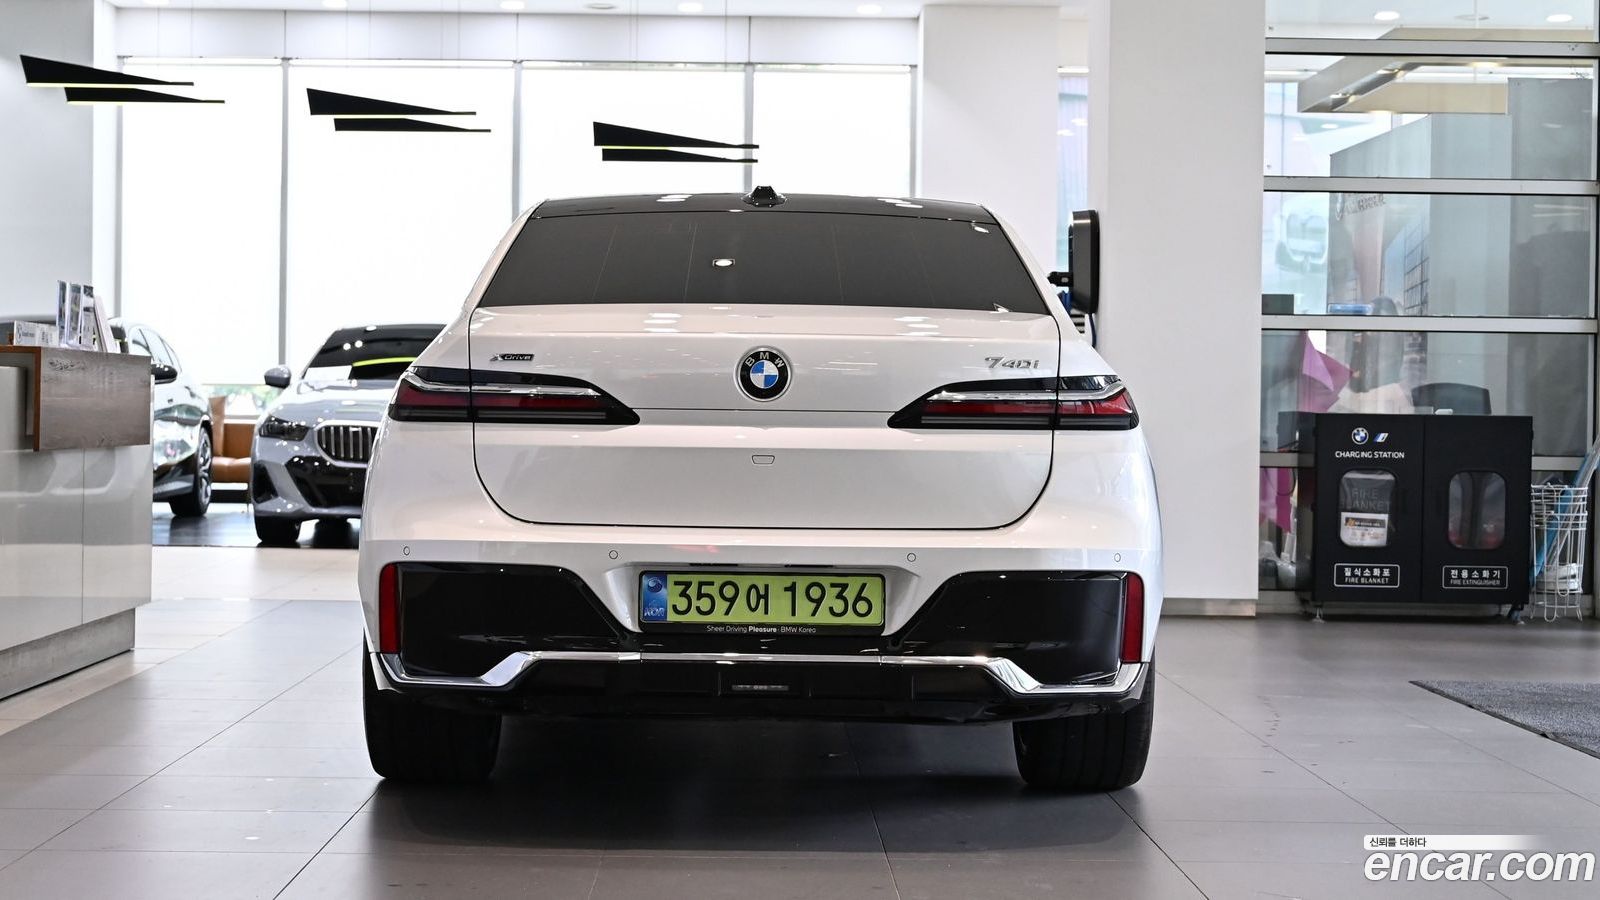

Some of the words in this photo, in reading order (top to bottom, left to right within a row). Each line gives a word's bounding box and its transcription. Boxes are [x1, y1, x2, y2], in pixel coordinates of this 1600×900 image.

[745, 351, 785, 368] BMW
[1335, 450, 1373, 459] CHARGING
[1373, 450, 1405, 459] STATION
[671, 580, 770, 616] 359어
[783, 581, 873, 618] 1936
[725, 625, 747, 634] Driving
[748, 625, 777, 633] Pleasure
